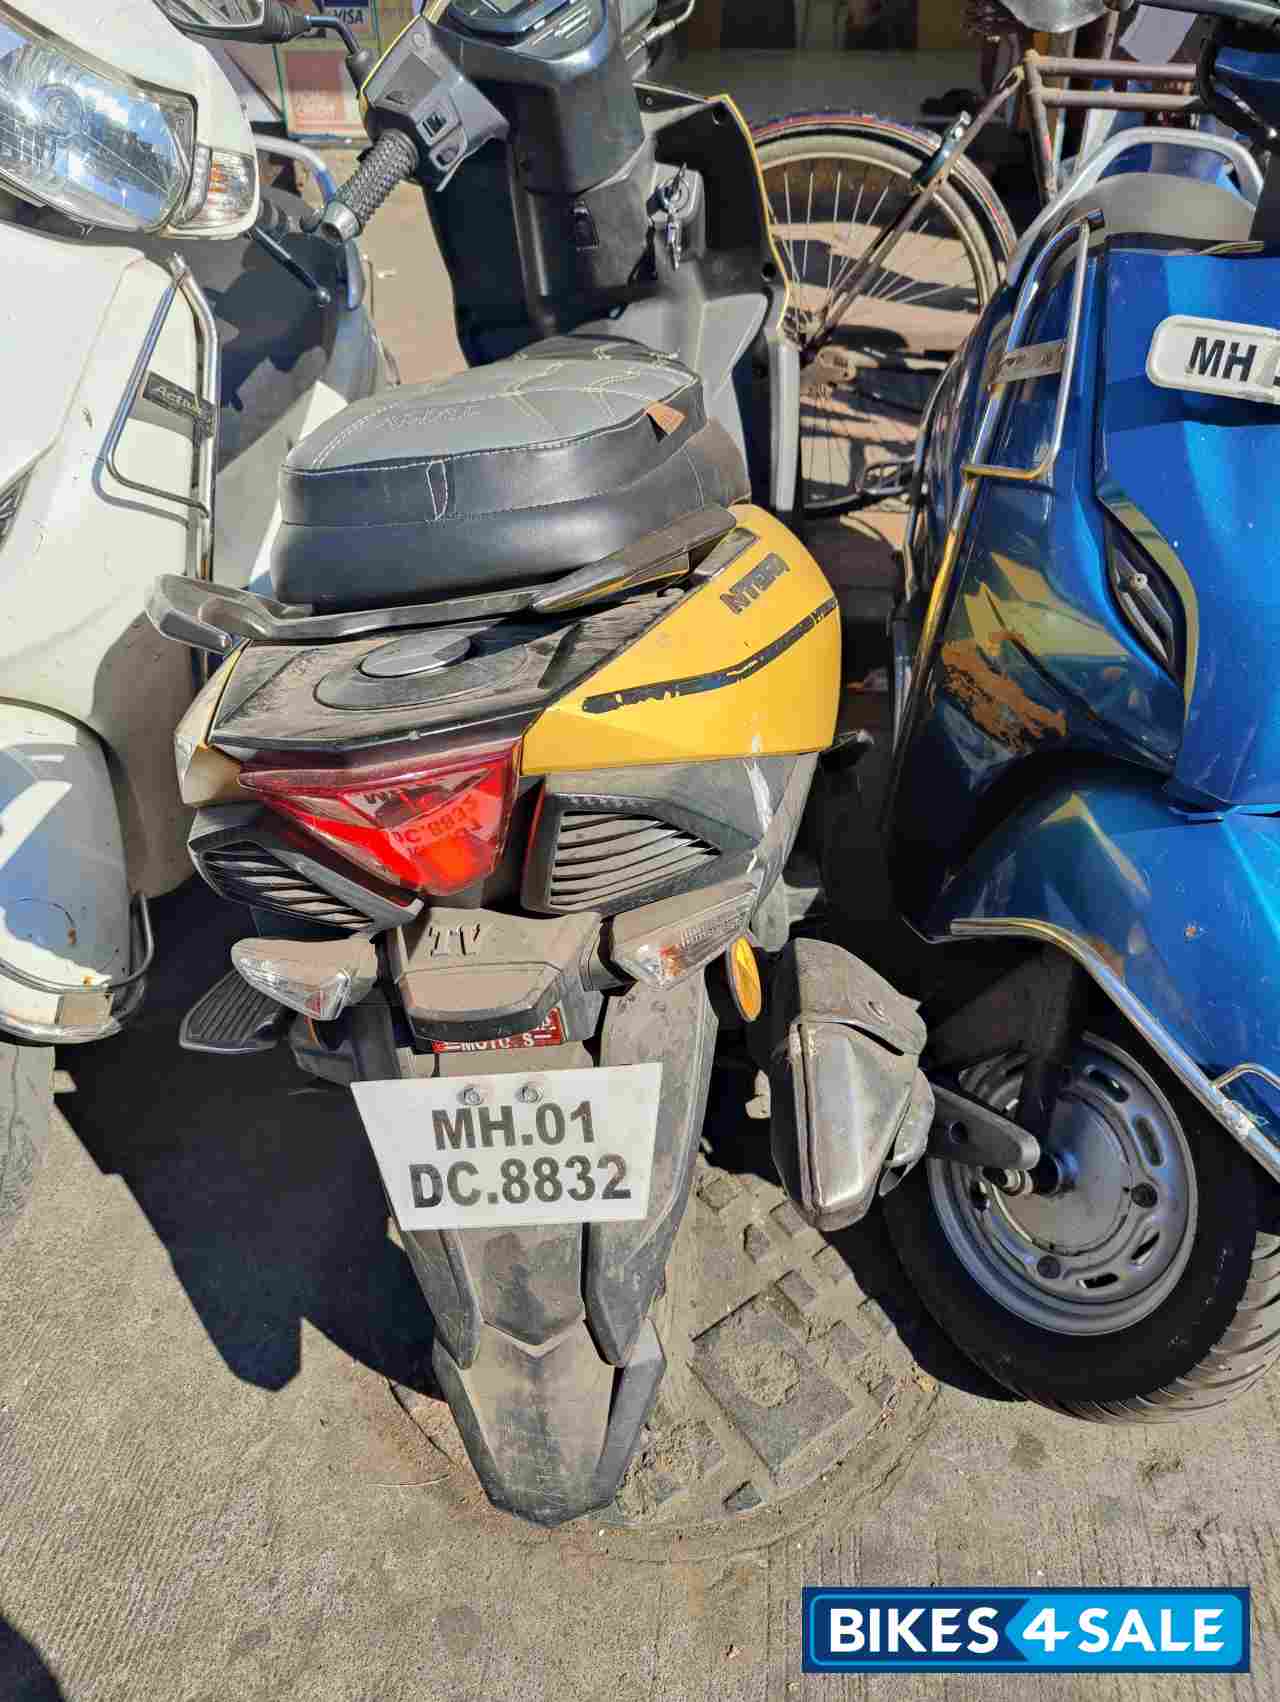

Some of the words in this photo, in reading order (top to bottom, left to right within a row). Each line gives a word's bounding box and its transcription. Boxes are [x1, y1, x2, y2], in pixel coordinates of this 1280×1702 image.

[335, 9, 363, 24] VISA
[1187, 336, 1257, 382] MH
[431, 1100, 595, 1150] MH.01
[408, 1154, 632, 1208] DC.8832
